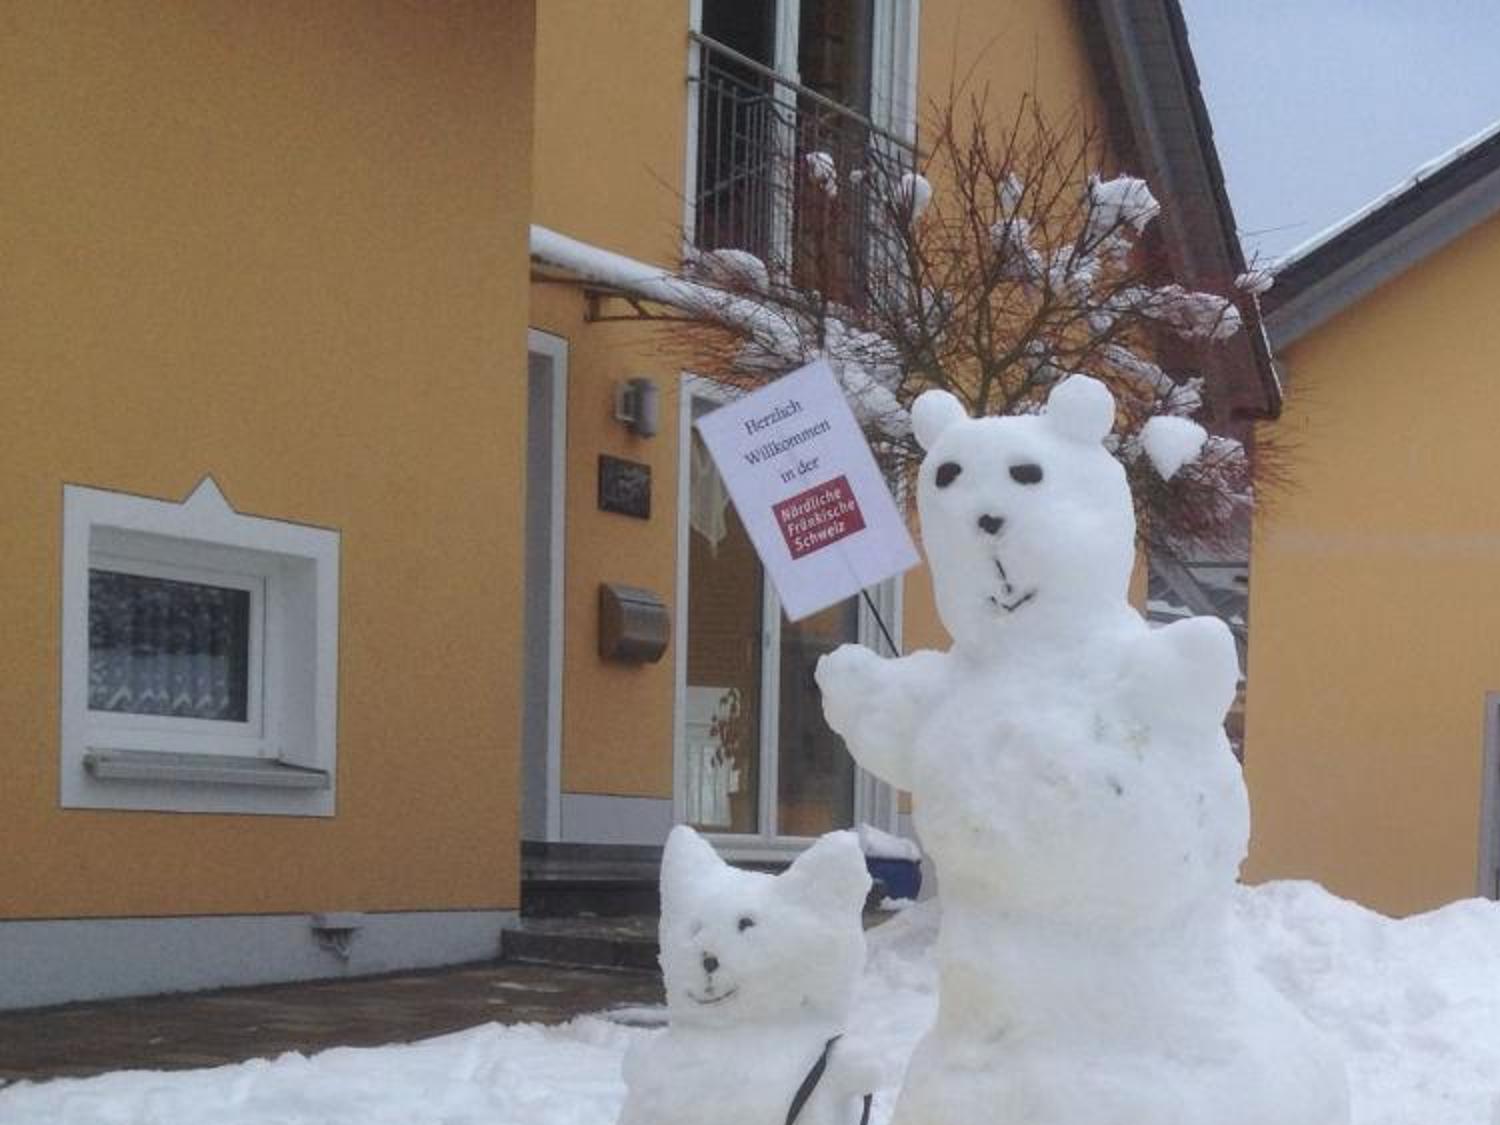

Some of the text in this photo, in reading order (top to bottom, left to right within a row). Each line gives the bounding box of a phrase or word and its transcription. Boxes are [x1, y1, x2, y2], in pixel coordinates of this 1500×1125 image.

[744, 399, 803, 435] Herzlich
[744, 418, 830, 465] Willkommen
[780, 457, 820, 483] in der
[780, 488, 842, 522] Nördliche
[787, 499, 856, 537] Fränkische
[794, 520, 846, 552] Schweiz
